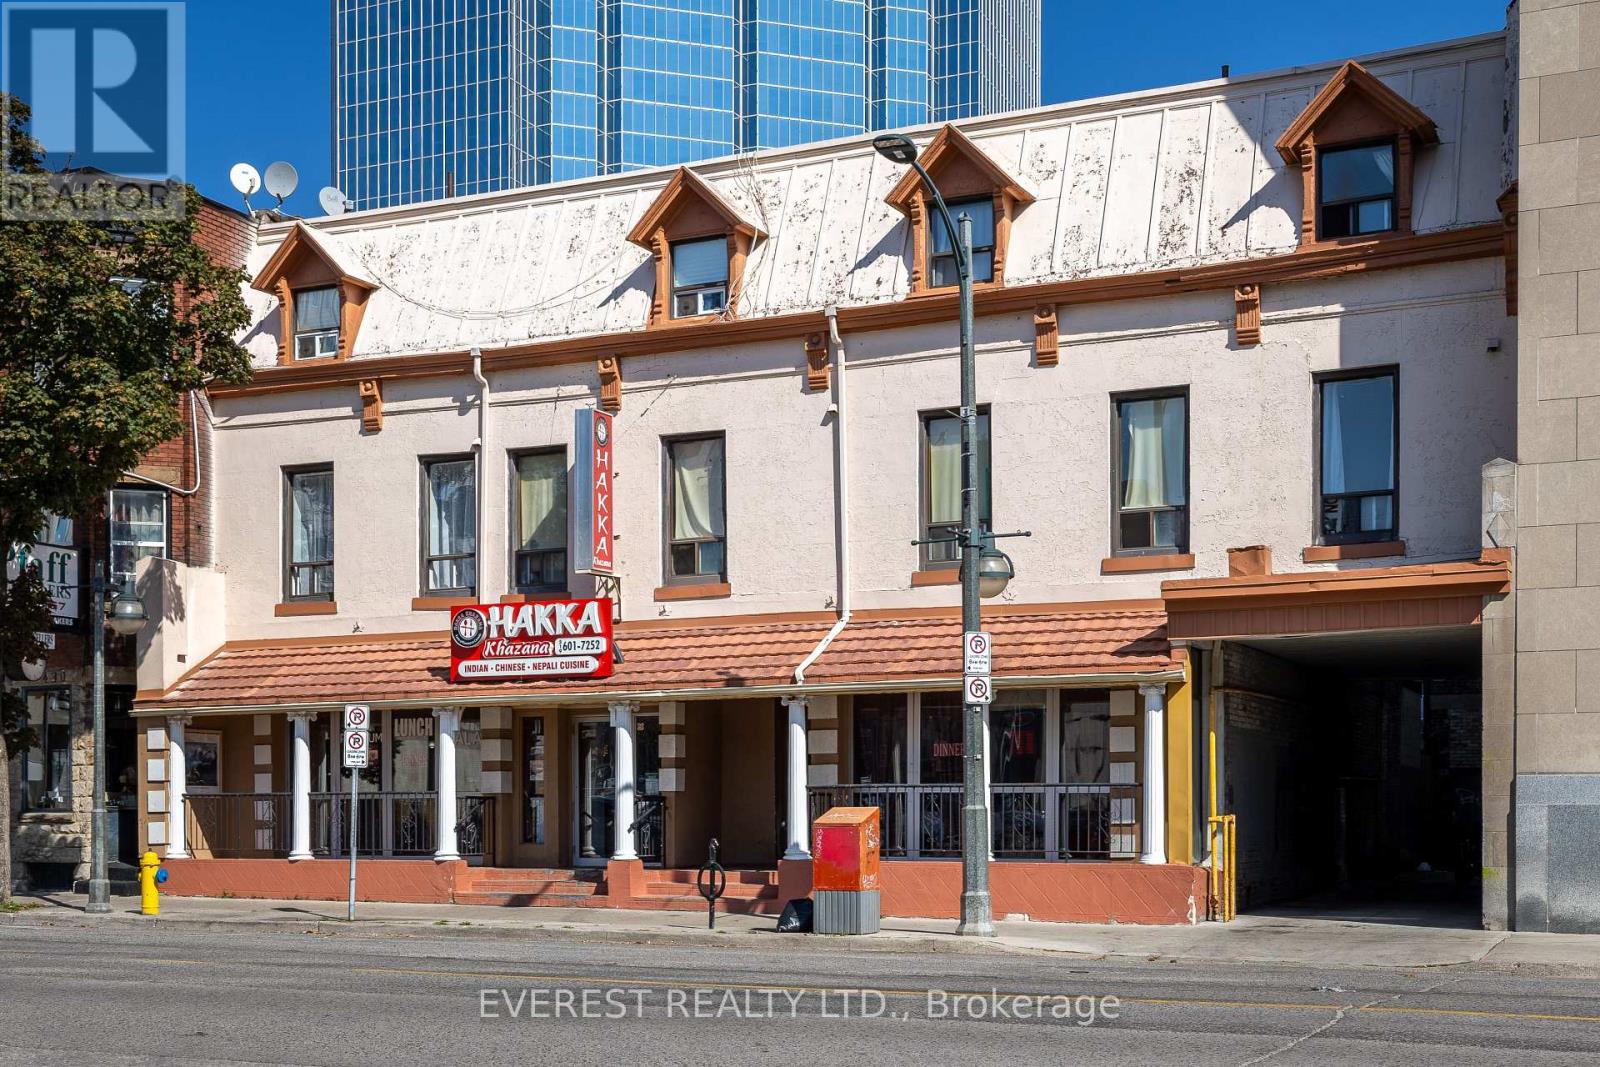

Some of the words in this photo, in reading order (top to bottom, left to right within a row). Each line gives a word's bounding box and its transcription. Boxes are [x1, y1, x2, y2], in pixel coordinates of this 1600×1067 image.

[596, 448, 609, 557] HAKKA
[488, 601, 603, 638] HAKKA
[485, 640, 549, 656] Khazana
[563, 640, 600, 651] 601-7252
[465, 664, 488, 673] INDIAN
[495, 663, 525, 672] CHINESE
[532, 662, 558, 671] NEPALI
[560, 661, 589, 669] CUISINE
[394, 717, 433, 737] LUNCH
